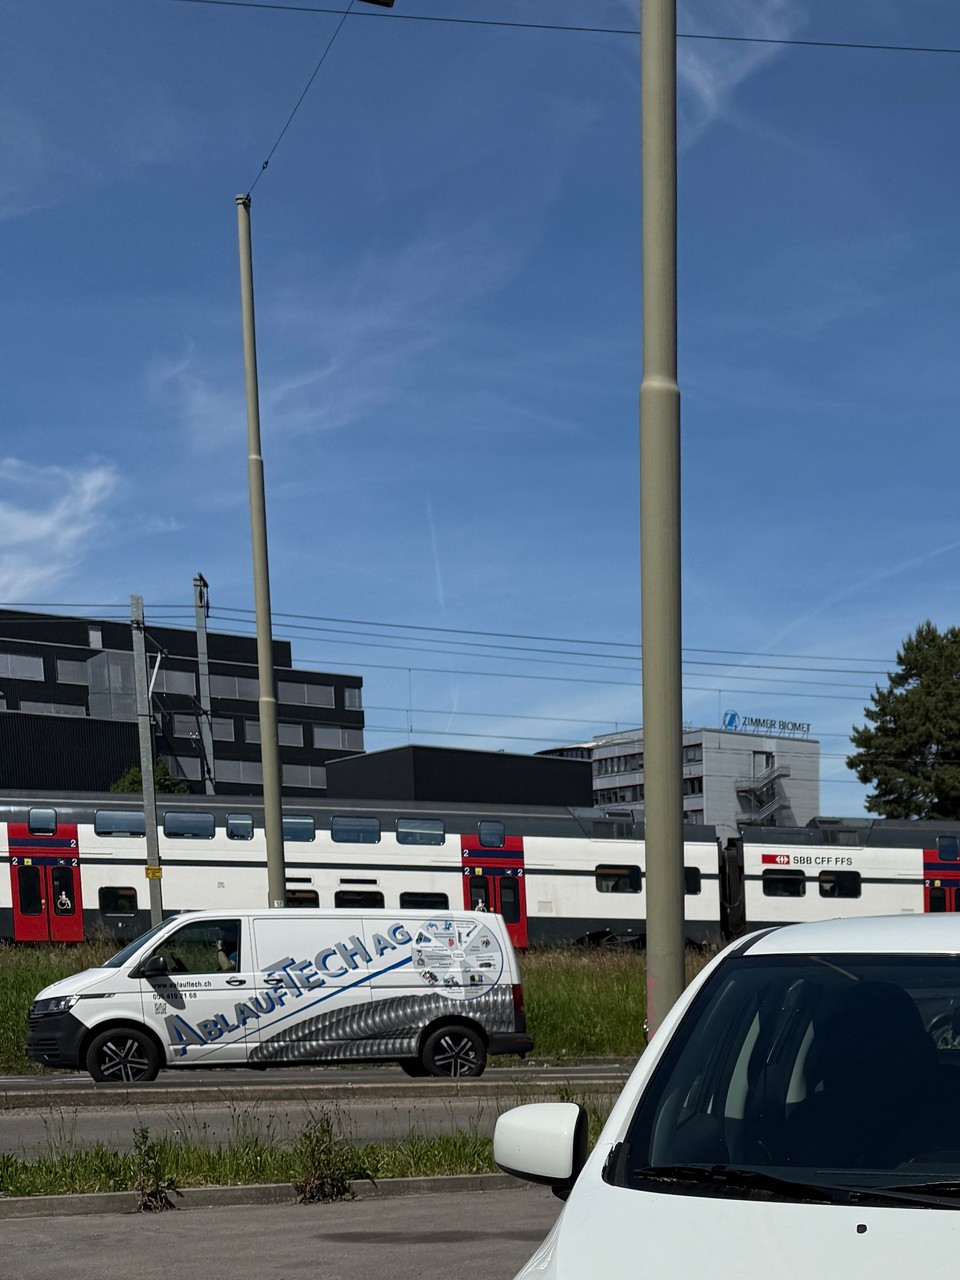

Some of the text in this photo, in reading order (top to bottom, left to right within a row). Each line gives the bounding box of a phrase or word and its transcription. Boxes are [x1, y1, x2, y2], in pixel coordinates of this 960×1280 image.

[742, 716, 811, 733] ZIMMER BIOMET
[70, 839, 76, 847] 2
[463, 849, 469, 857] 2
[12, 857, 18, 865] 2
[71, 858, 77, 866] 2
[793, 856, 853, 866] SBB CFF FFS
[464, 867, 470, 875] 2
[517, 869, 523, 877] 2
[372, 922, 413, 957] AG
